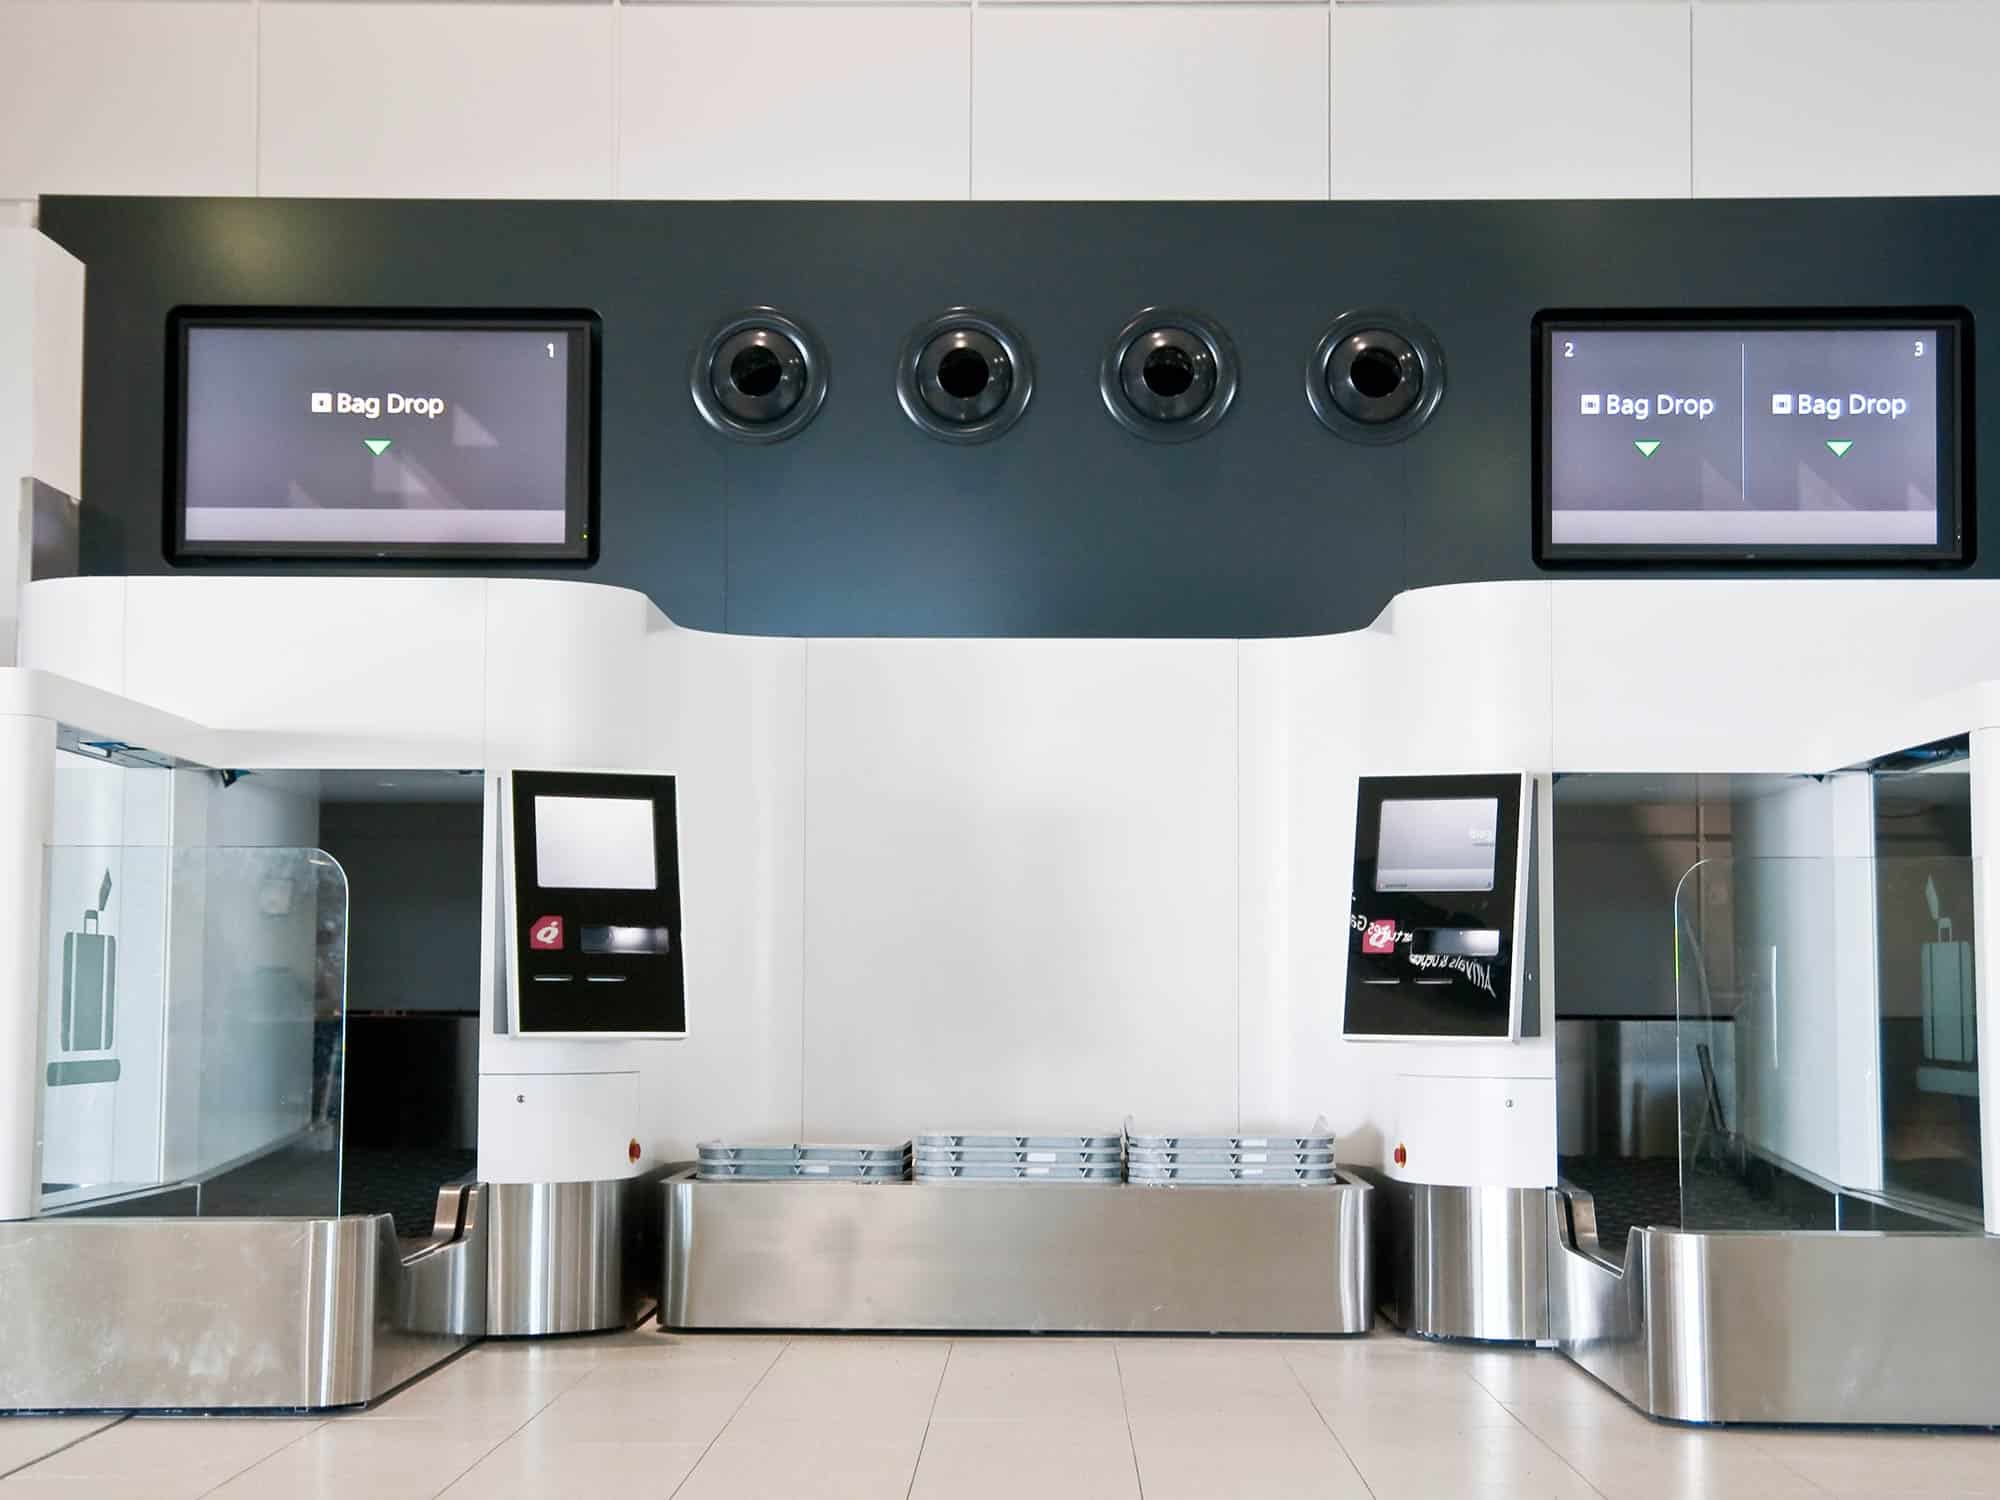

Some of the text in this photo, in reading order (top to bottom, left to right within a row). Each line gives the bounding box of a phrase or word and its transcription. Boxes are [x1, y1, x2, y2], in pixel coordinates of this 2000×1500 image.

[546, 343, 555, 358] 1
[1564, 342, 1574, 358] 2
[1914, 341, 1924, 357] 3
[337, 392, 444, 419] Bag Drop
[1606, 394, 1714, 420] Bag Drop
[1798, 393, 1907, 420] Bag Drop
